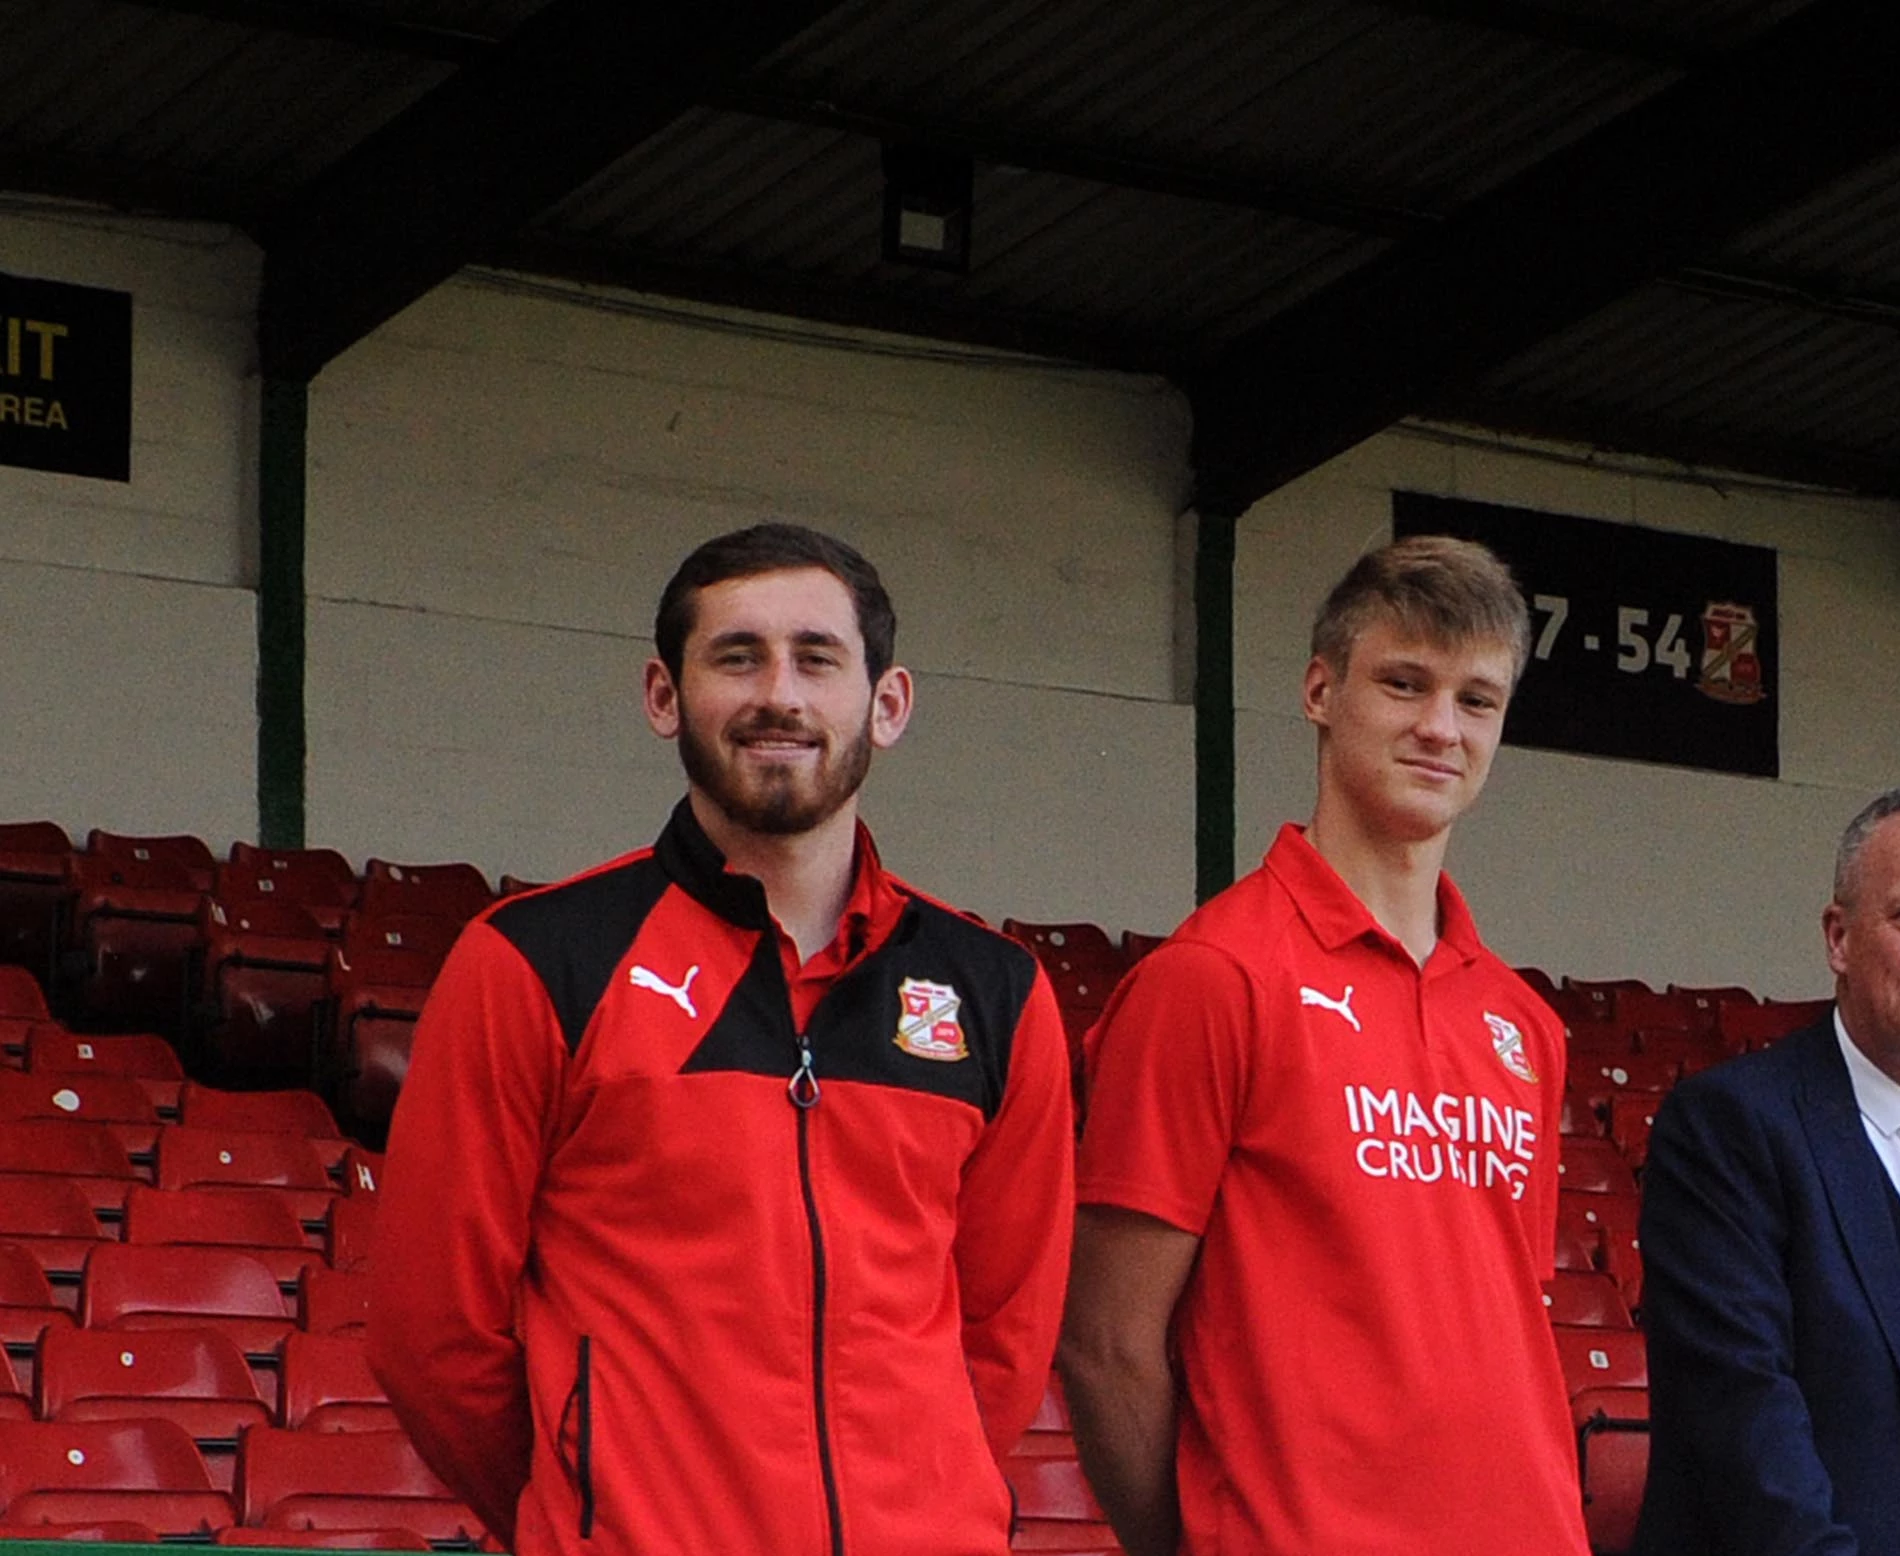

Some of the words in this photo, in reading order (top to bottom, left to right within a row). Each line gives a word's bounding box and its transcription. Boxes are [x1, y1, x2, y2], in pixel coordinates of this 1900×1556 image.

[0, 316, 69, 382] IT
[1617, 605, 1691, 679] 54
[1344, 1085, 1536, 1160] IMAGINE
